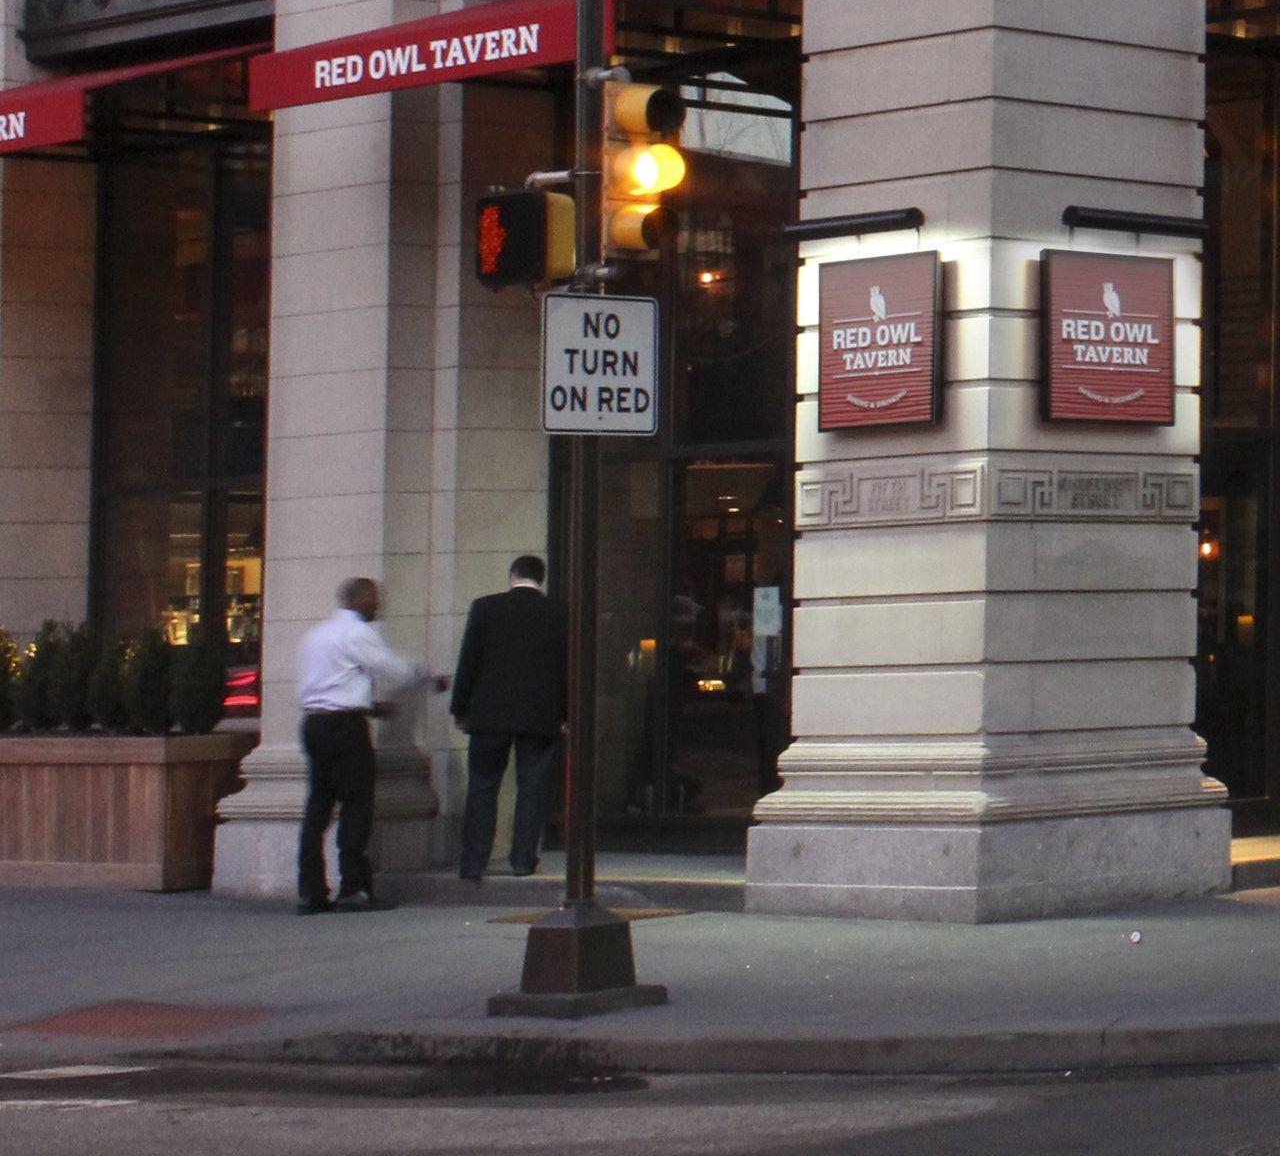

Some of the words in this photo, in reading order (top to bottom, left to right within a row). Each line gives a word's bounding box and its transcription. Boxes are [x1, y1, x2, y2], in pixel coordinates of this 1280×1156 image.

[314, 55, 363, 88] RED
[368, 44, 426, 79] OWL
[429, 23, 540, 69] TAVERN
[583, 311, 620, 339] NO
[832, 327, 871, 350] RED
[876, 322, 922, 345] OWL
[1062, 318, 1105, 341] RED
[1110, 321, 1159, 344] OWL
[564, 348, 639, 376] TURN
[843, 348, 912, 370] TAVERN
[1073, 344, 1149, 365] TAVERN
[550, 385, 588, 412] ON
[597, 386, 650, 413] RED
